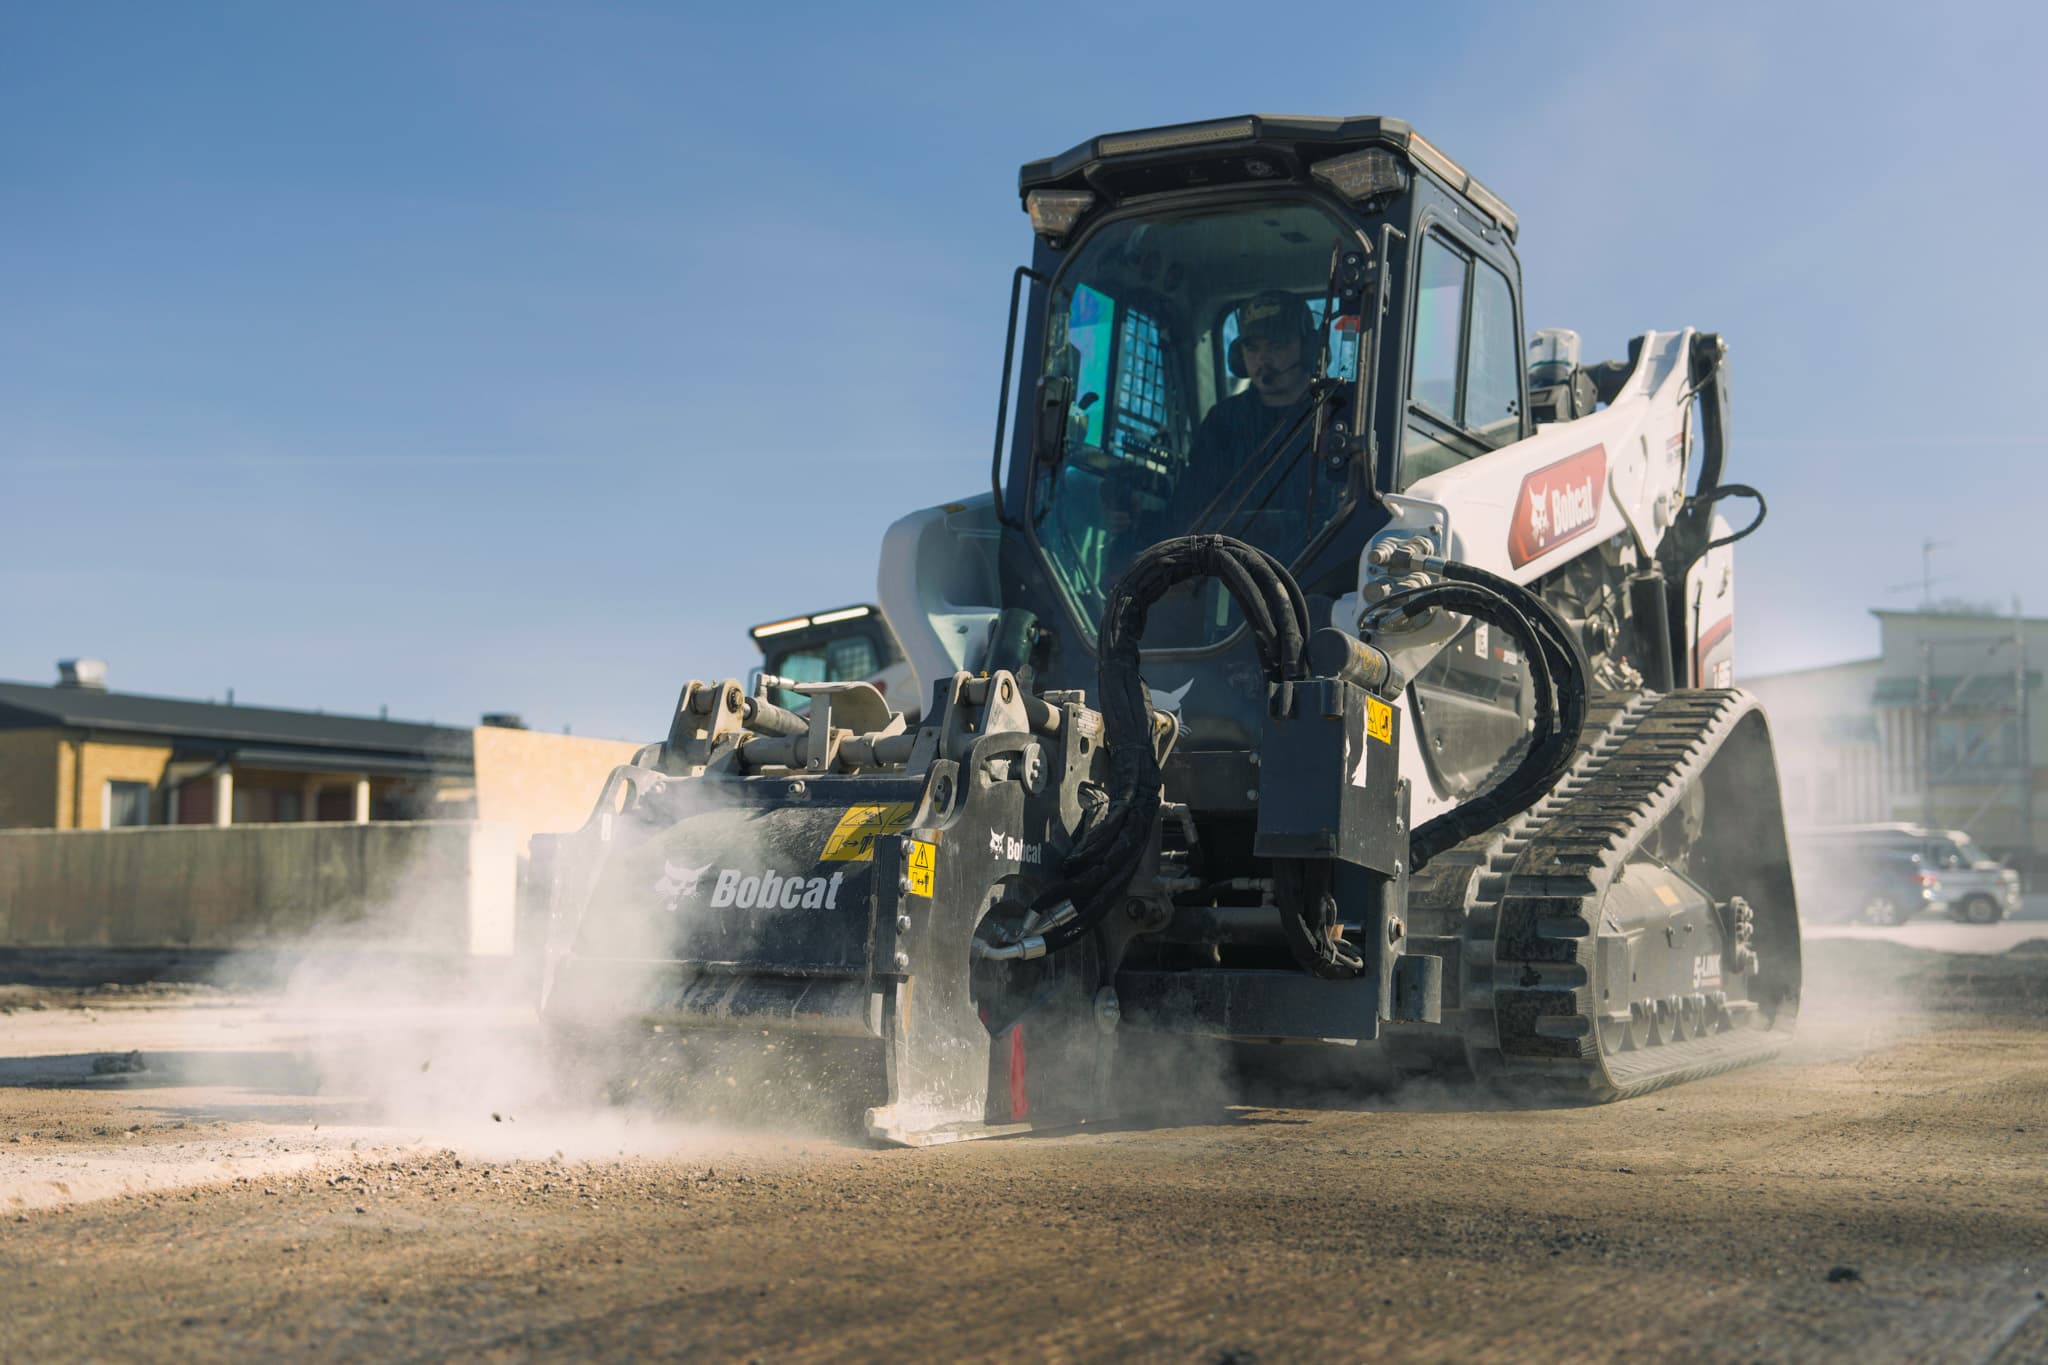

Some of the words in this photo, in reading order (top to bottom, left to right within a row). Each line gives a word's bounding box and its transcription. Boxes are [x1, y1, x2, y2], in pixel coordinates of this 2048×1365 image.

[1552, 475, 1594, 537] Bobcat
[1007, 836, 1042, 865] Bobcat
[710, 868, 845, 909] Bobcat
